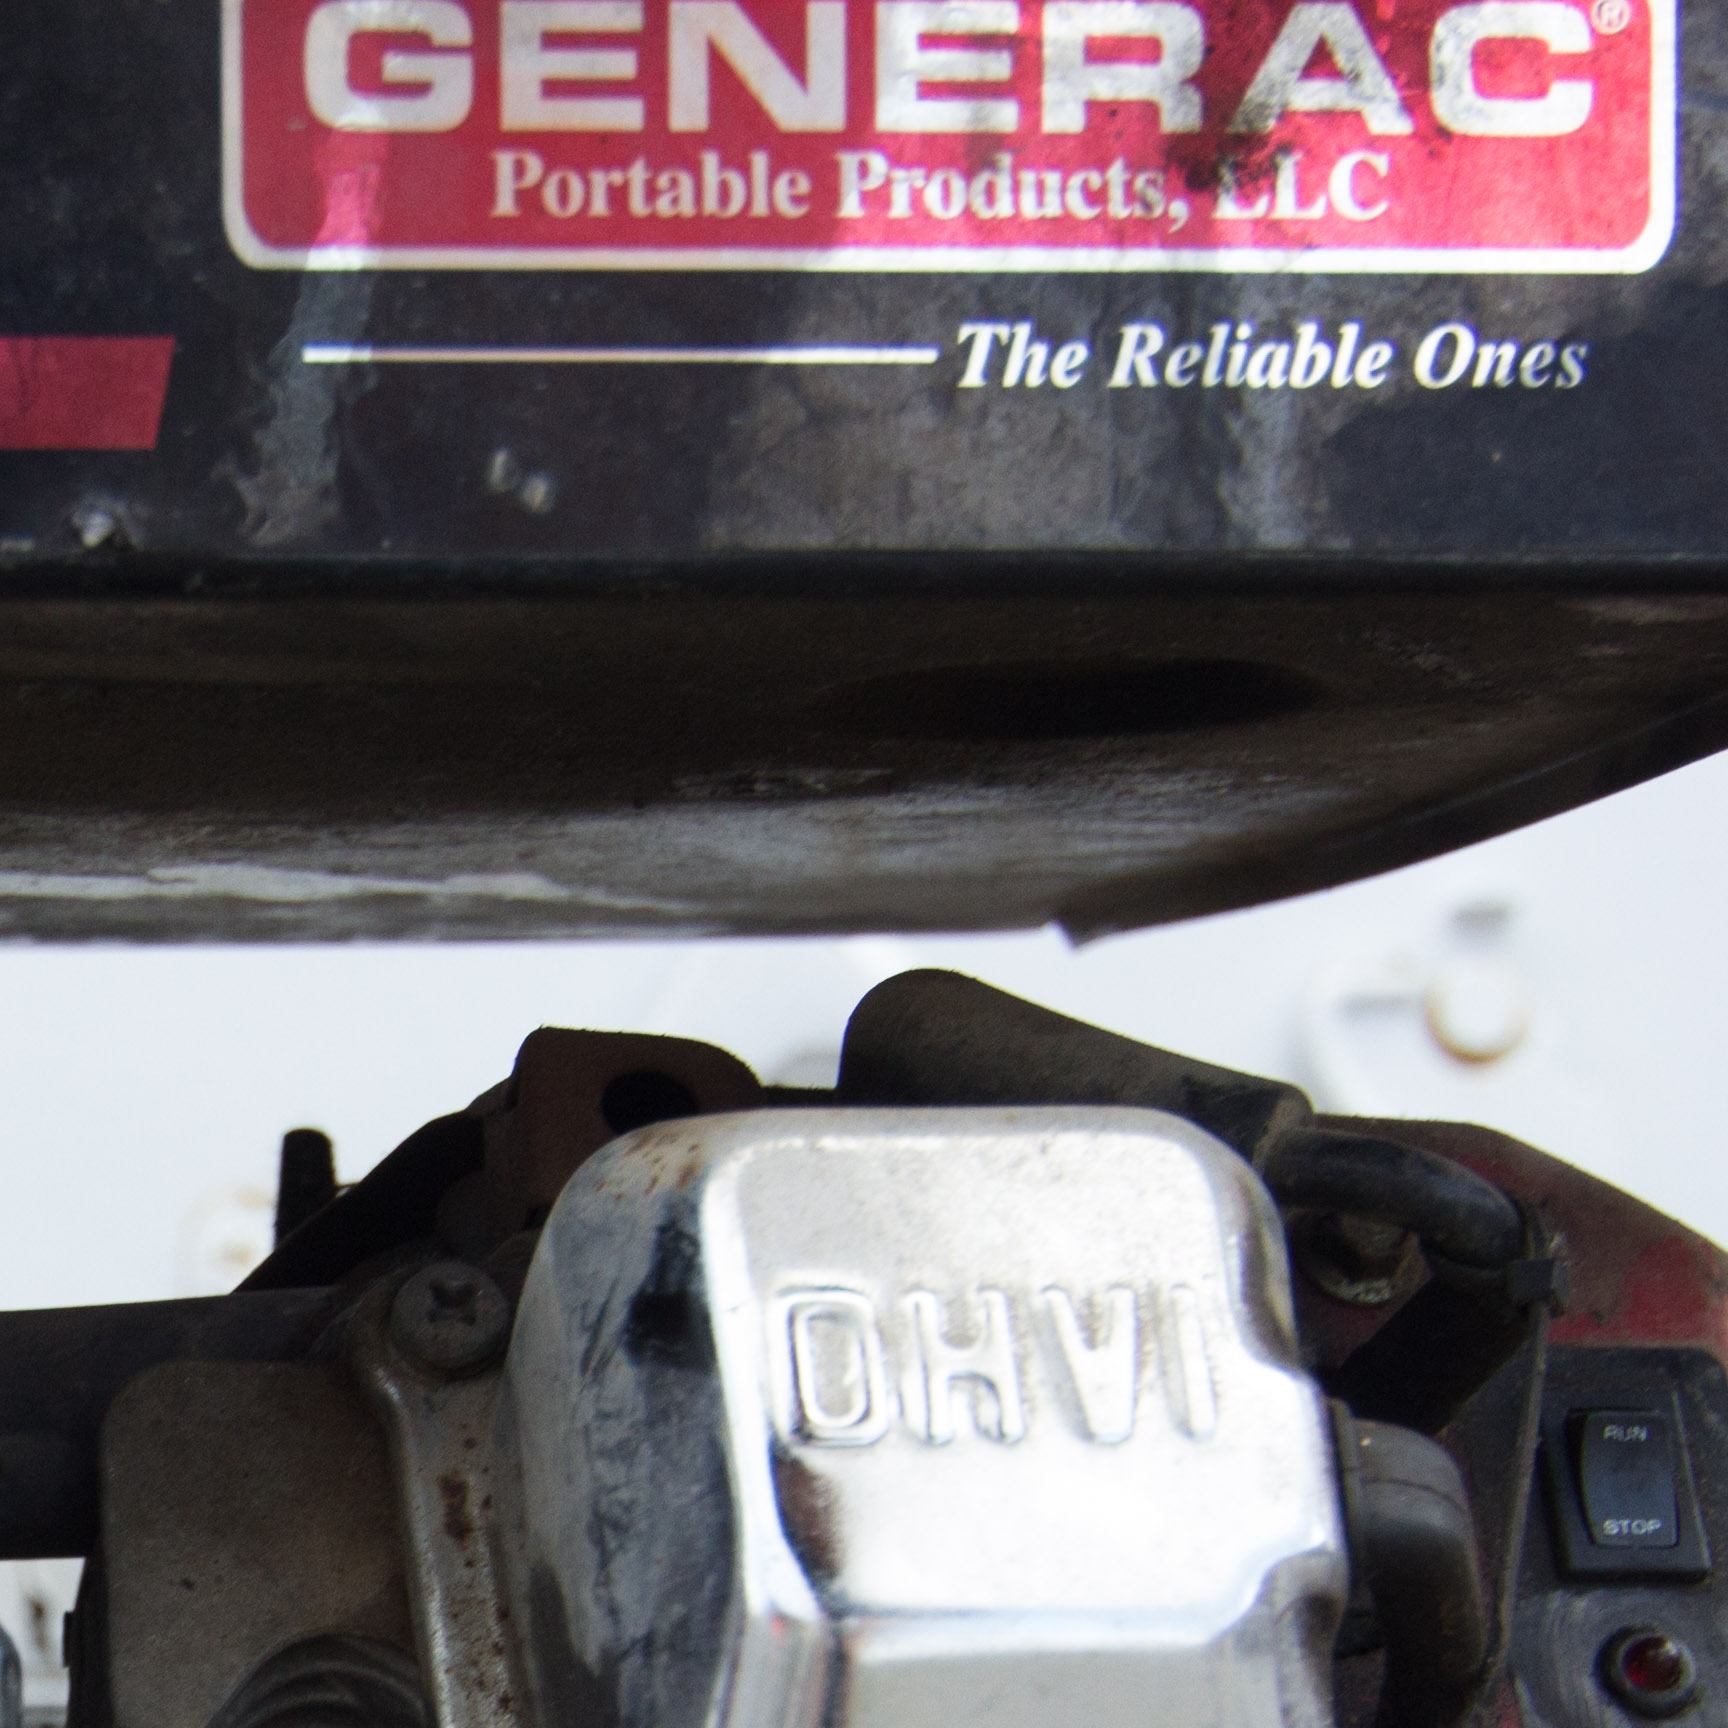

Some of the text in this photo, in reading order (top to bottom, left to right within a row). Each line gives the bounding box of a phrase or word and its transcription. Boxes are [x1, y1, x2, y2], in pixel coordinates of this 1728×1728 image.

[304, 0, 1594, 136] GENERAC
[488, 149, 1391, 233] Portable Products, LLC
[957, 322, 1589, 390] The Reliable Ones
[772, 1284, 1220, 1448] OHVI
[1603, 1518, 1663, 1535] STOP
